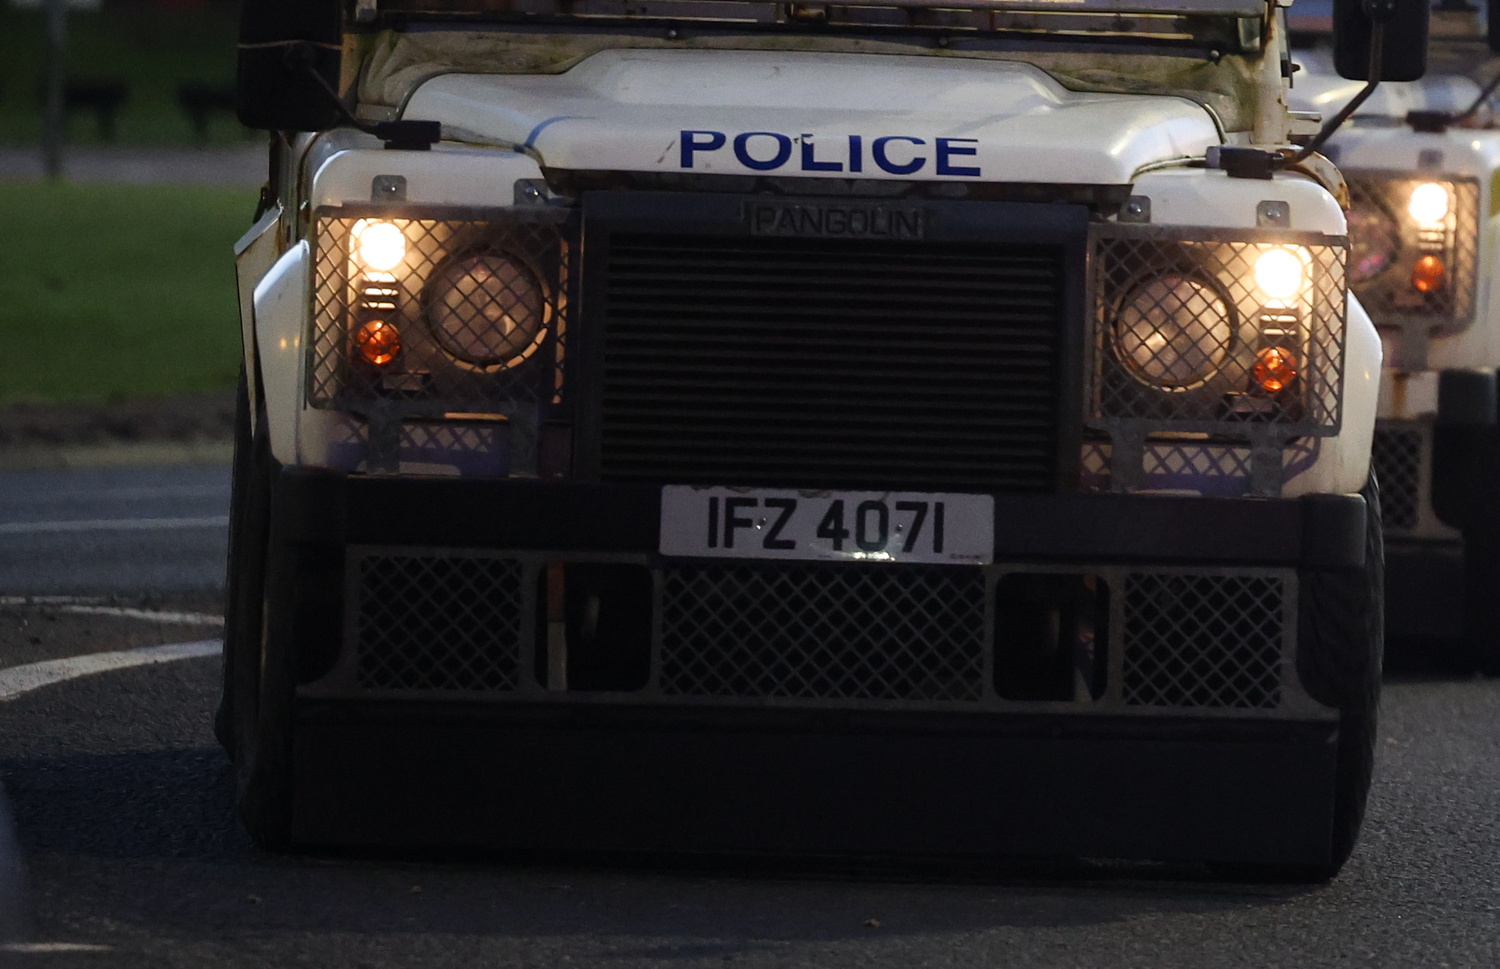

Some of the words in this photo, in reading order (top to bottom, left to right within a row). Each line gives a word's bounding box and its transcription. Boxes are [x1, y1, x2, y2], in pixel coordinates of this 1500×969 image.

[680, 130, 981, 177] POLICE
[756, 206, 919, 237] PANGOLIN
[707, 496, 798, 551] IFZ
[816, 499, 945, 554] 4071
